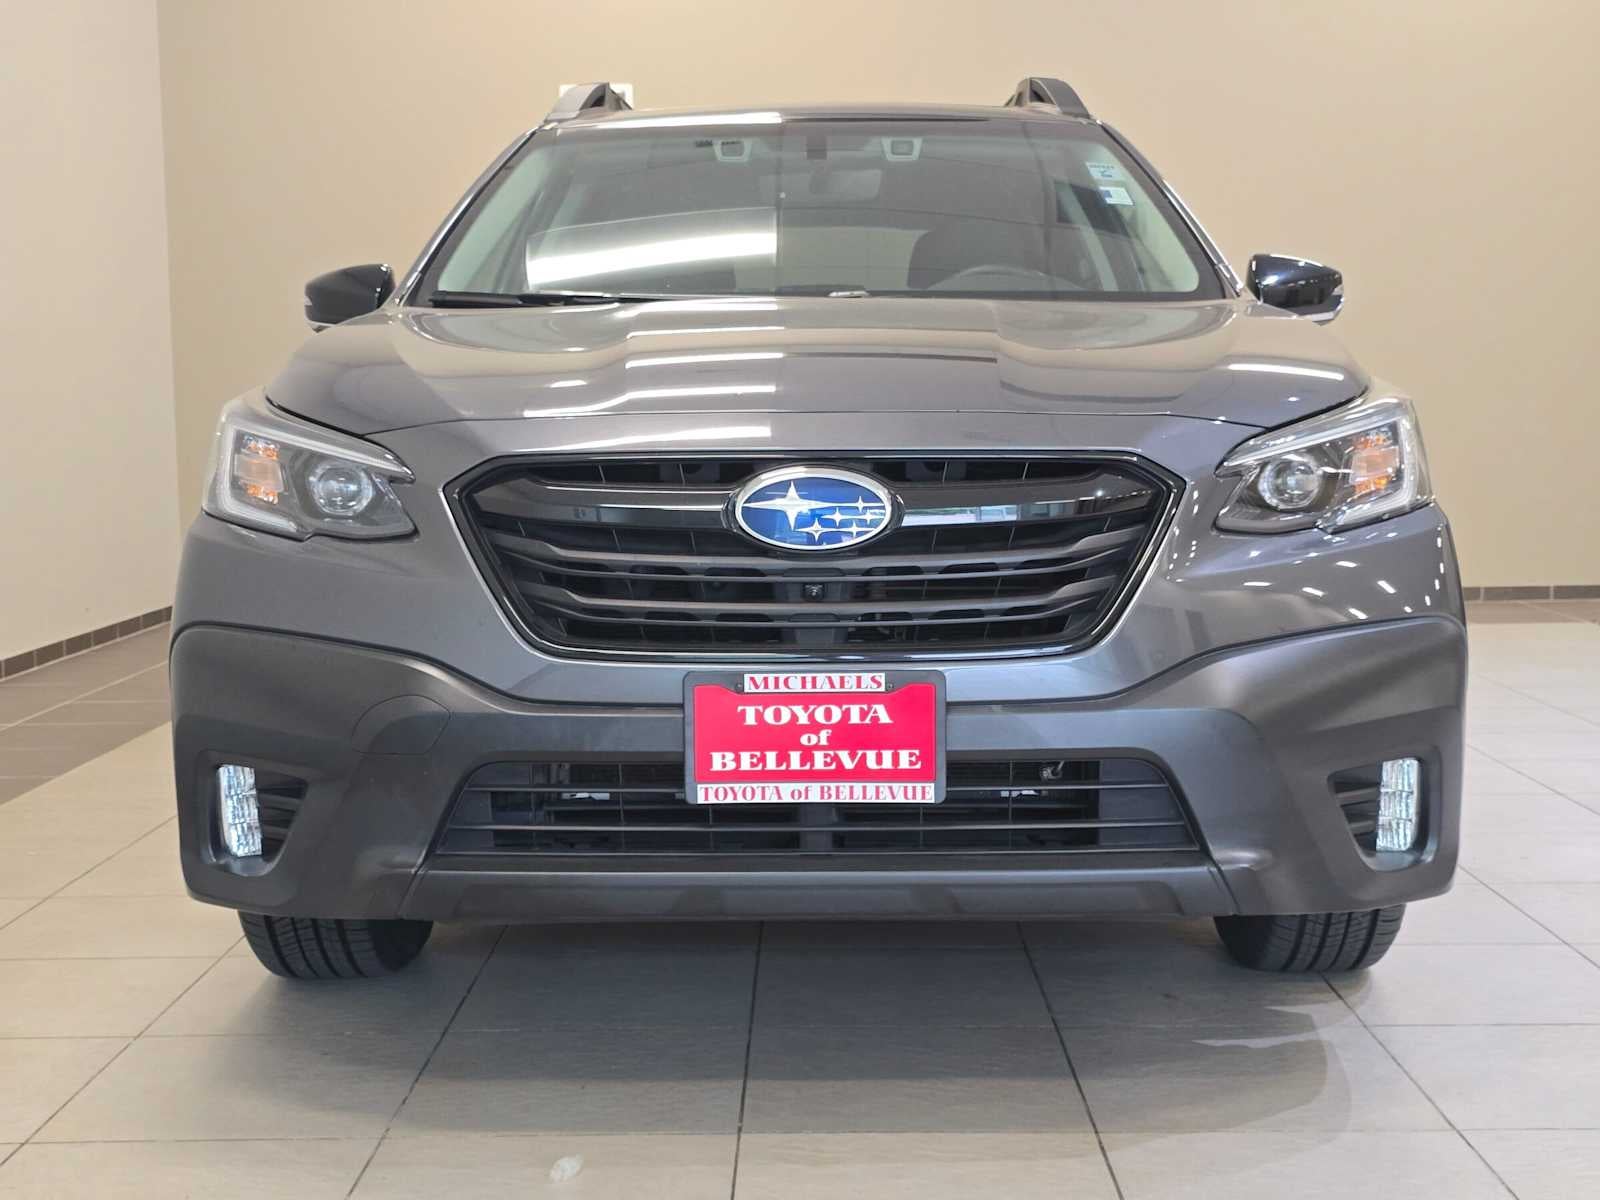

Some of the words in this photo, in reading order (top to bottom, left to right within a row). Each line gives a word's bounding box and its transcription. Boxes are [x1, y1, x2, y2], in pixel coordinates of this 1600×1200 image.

[748, 675, 883, 690] MICHAELS
[737, 704, 894, 726] TOYOTA
[799, 729, 832, 746] of
[709, 749, 922, 772] BELLEVUE
[700, 786, 784, 802] TOYOTA
[790, 785, 813, 801] of
[819, 784, 933, 801] BELLEVUE
